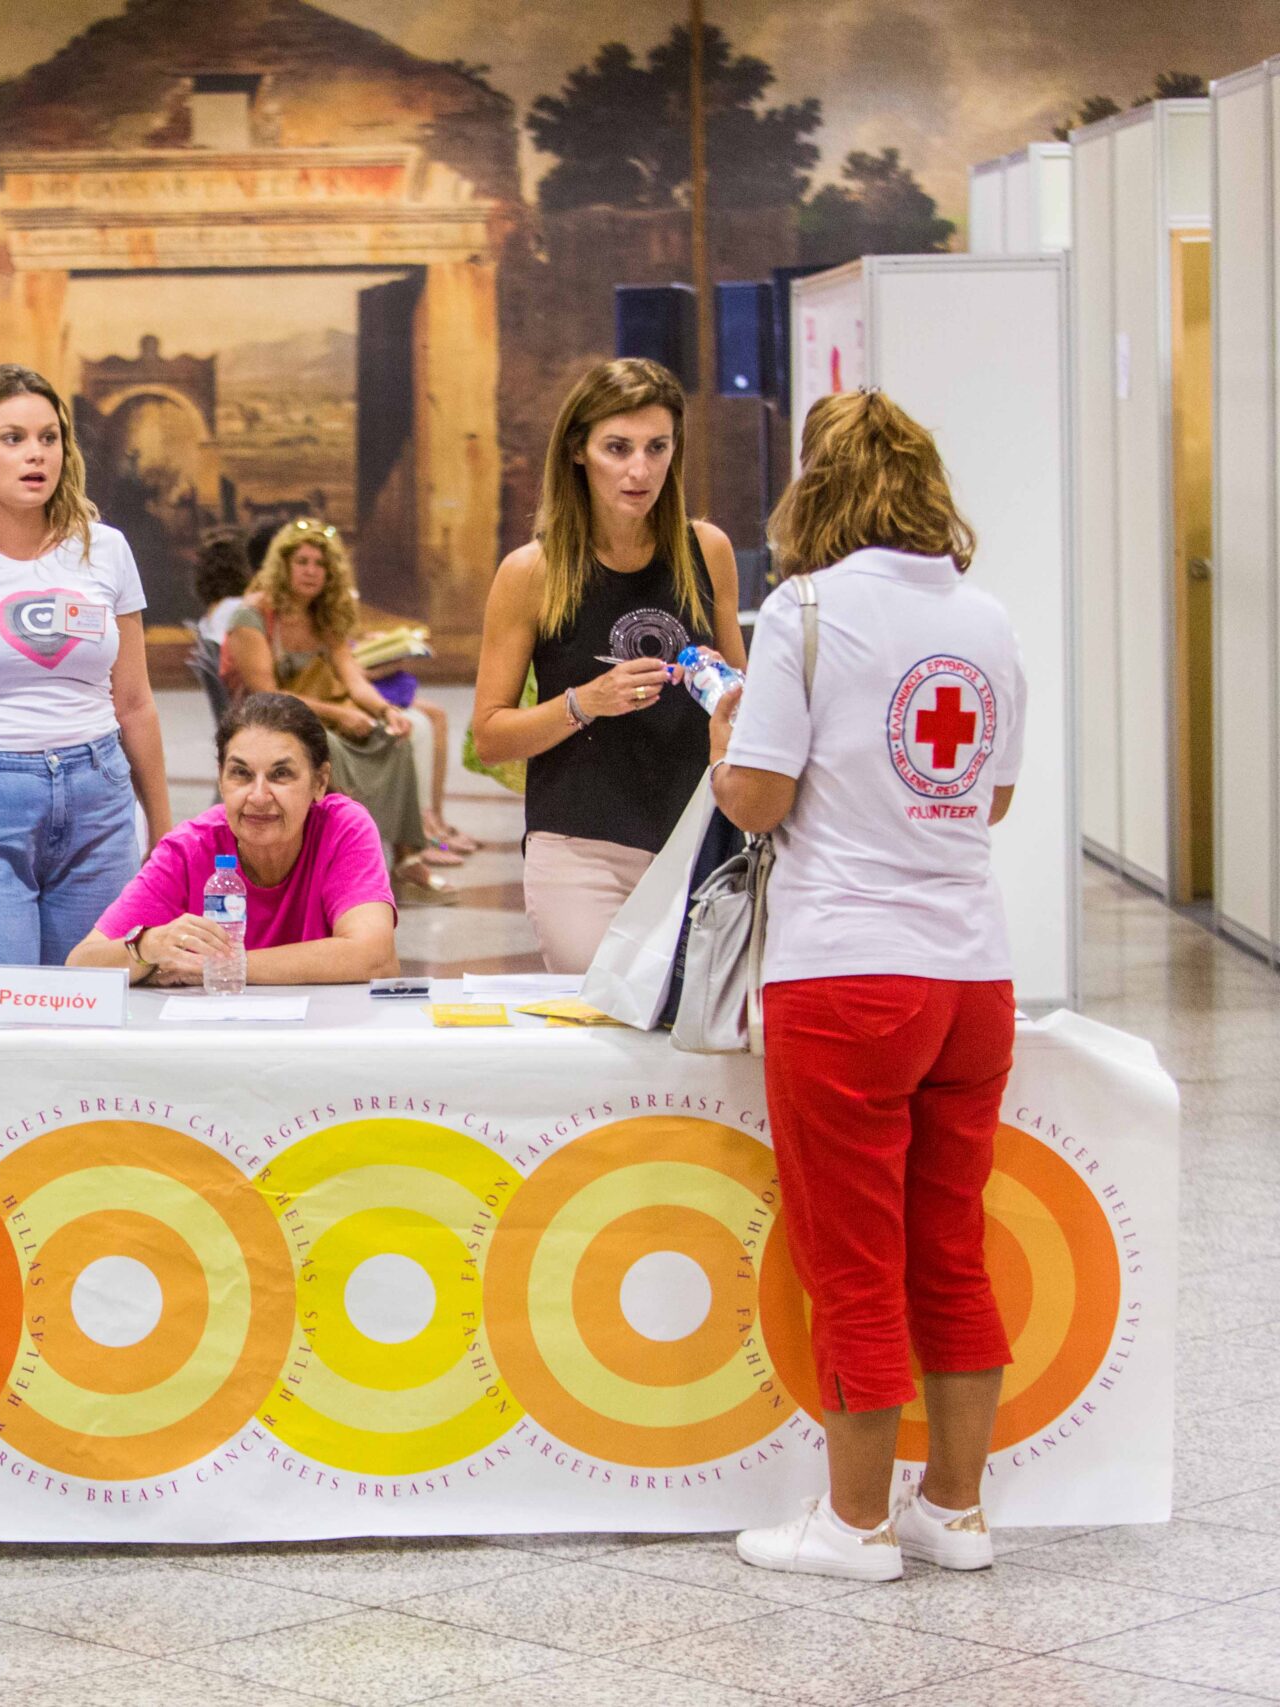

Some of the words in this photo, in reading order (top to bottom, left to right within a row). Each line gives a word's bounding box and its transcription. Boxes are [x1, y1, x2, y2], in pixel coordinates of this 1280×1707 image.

[934, 783, 960, 795] RED
[263, 1103, 338, 1149] RGETS
[353, 1096, 449, 1117] BREAST
[463, 1112, 510, 1146] CAN
[461, 1176, 510, 1282] FASHION
[513, 1101, 614, 1168] TARGETS
[629, 1093, 727, 1115] BREAST
[740, 1110, 768, 1133] CA
[1015, 1105, 1101, 1176] CANCER
[1101, 1184, 1145, 1275] HELLAS
[2, 1194, 46, 1287] HELLAS
[79, 1097, 175, 1119] BREAST
[188, 1114, 273, 1184] CANCER
[275, 1191, 319, 1284] HELLAS
[7, 1314, 47, 1408] HELLAS
[86, 1480, 180, 1504] BREAST
[195, 1413, 278, 1484] CANCER
[279, 1311, 320, 1403] HELLAS
[461, 1311, 510, 1415] FASHION
[515, 1421, 612, 1484] TARGETS
[629, 1467, 724, 1490] BREAST
[739, 1439, 785, 1471] CAN
[737, 1307, 785, 1409] FASHION
[1012, 1400, 1098, 1469] CANCER
[1099, 1301, 1144, 1391] HELLAS
[267, 1446, 340, 1492] RGETS
[357, 1475, 451, 1498] BREAST
[467, 1445, 512, 1480] CAN
